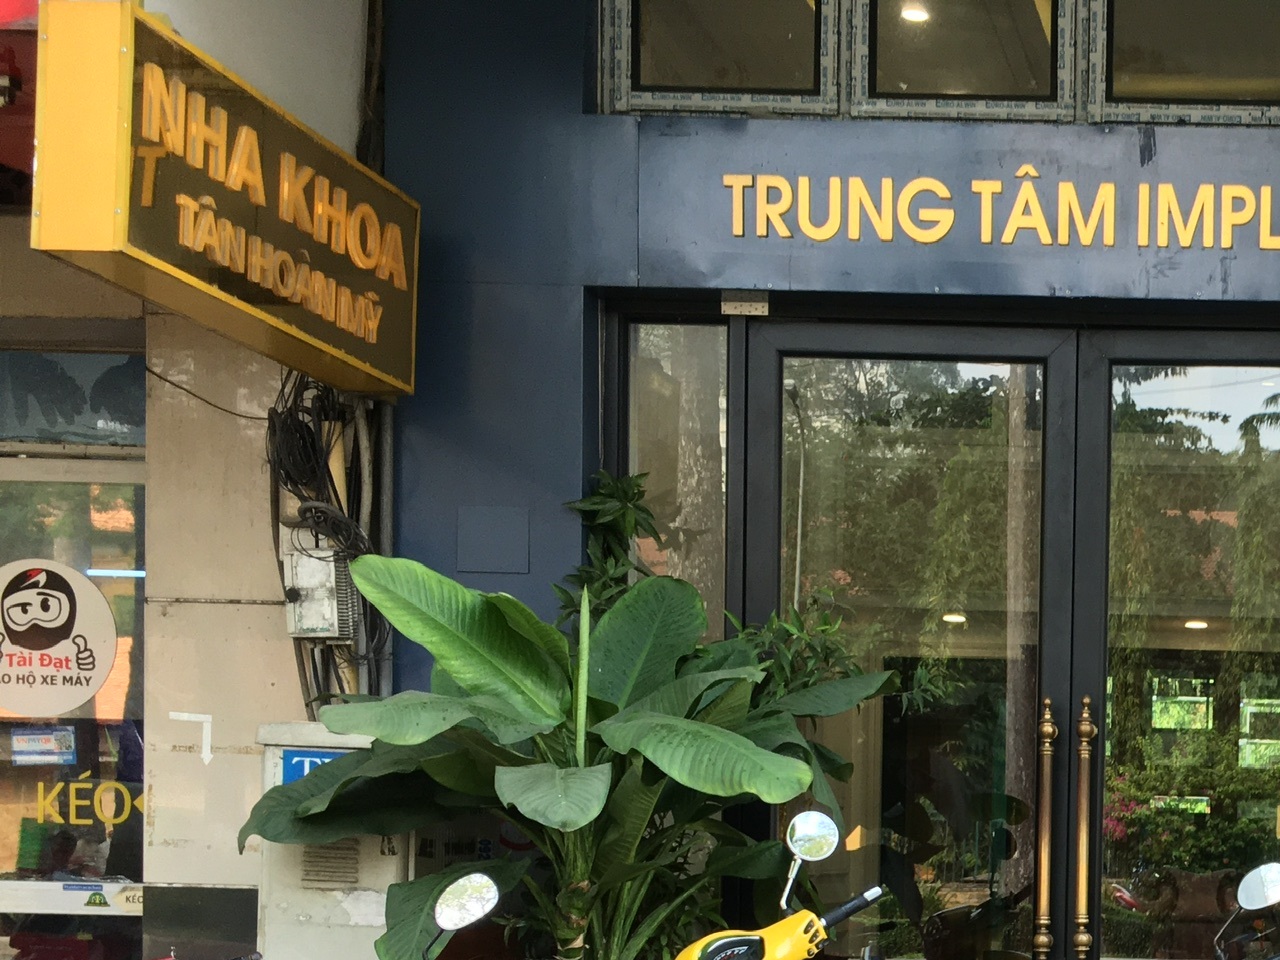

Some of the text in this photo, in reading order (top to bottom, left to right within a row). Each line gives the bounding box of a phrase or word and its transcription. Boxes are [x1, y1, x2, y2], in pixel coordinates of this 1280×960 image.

[141, 62, 407, 291] NHA KHOA
[722, 174, 955, 244] TRUNG
[971, 164, 1116, 246] TÂM
[175, 193, 246, 274] TÂN
[5, 651, 72, 672] Tài Đạt
[16, 671, 36, 688] HỘ
[40, 675, 58, 686] XE
[62, 672, 92, 687] MÁY
[37, 769, 131, 825] KÉO
